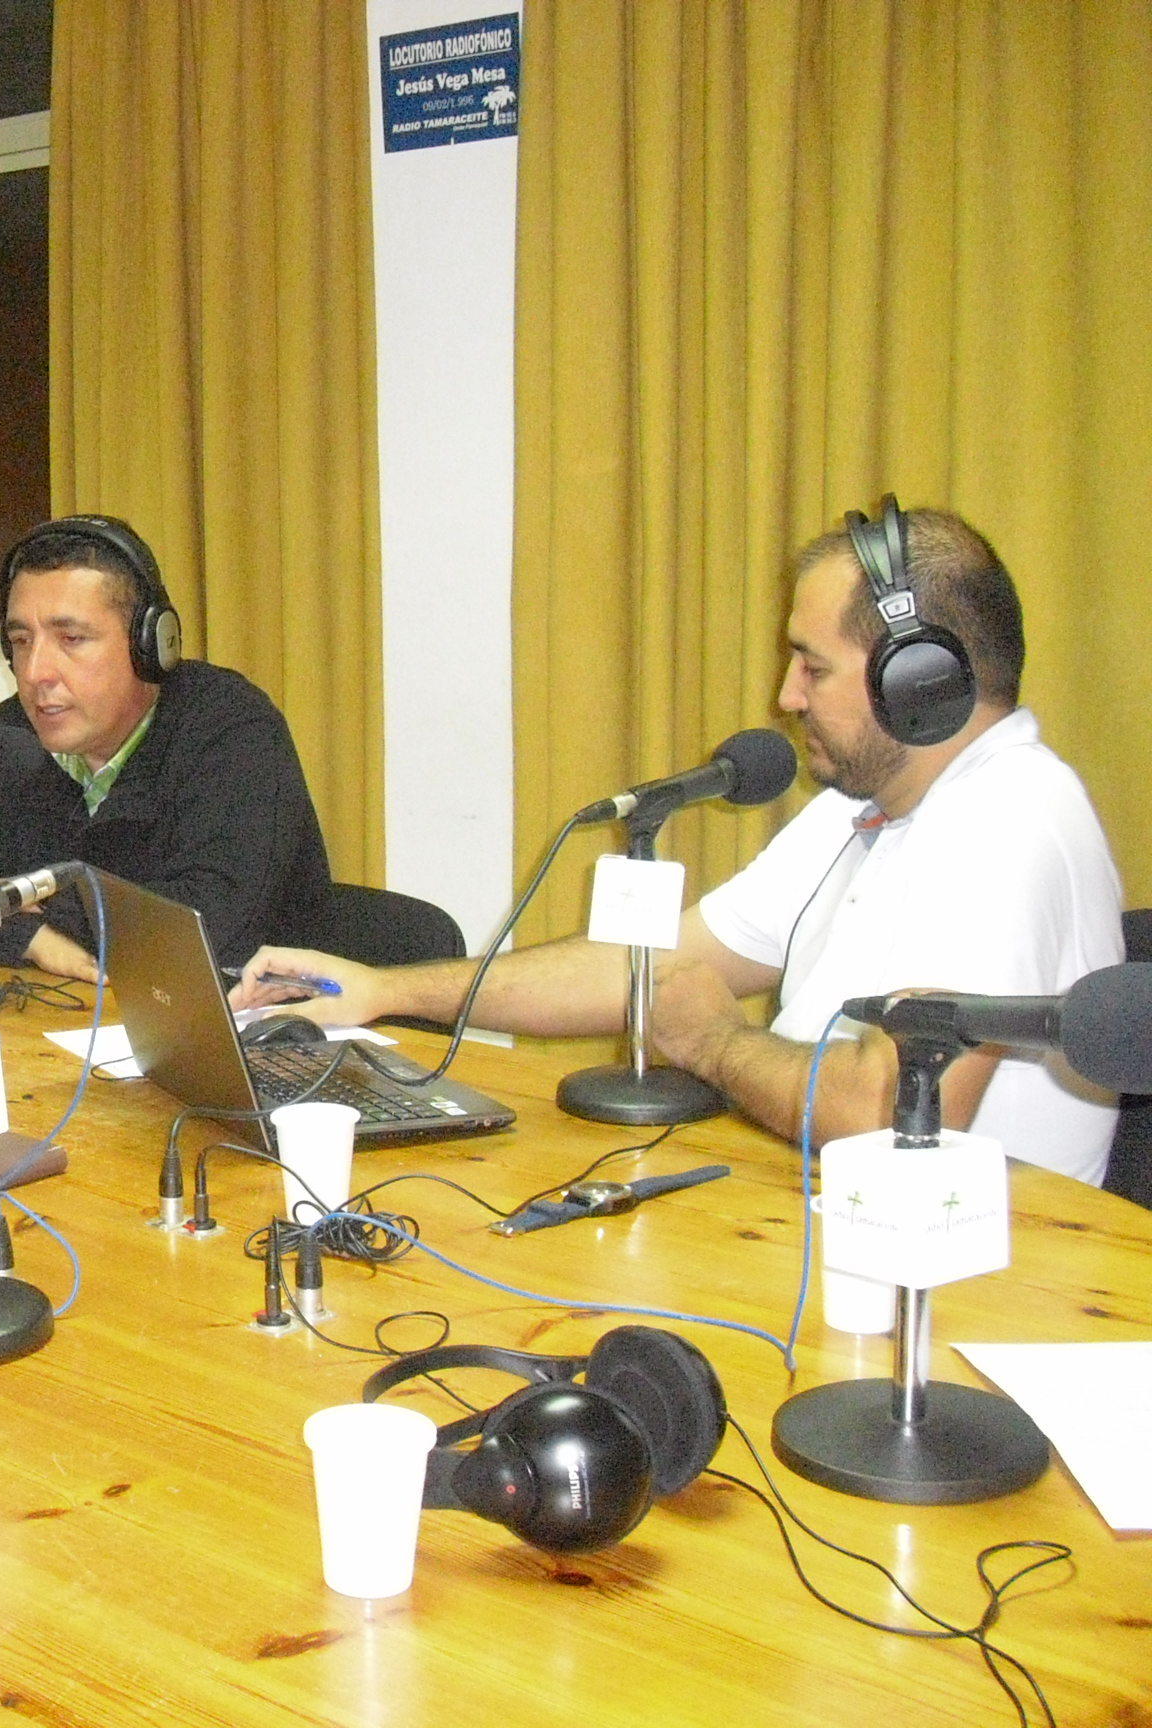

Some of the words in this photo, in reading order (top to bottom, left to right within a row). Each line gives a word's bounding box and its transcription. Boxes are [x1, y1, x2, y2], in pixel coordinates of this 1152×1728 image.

[389, 39, 443, 67] LOCUTORIO
[445, 28, 512, 57] RADIOFÓNICO
[396, 76, 434, 96] Jesús
[436, 72, 469, 91] Vega
[471, 67, 506, 84] Mesa
[392, 122, 421, 134] RADIO
[423, 111, 488, 129] TAMARACEITE
[568, 1464, 583, 1510] PHILIPS
